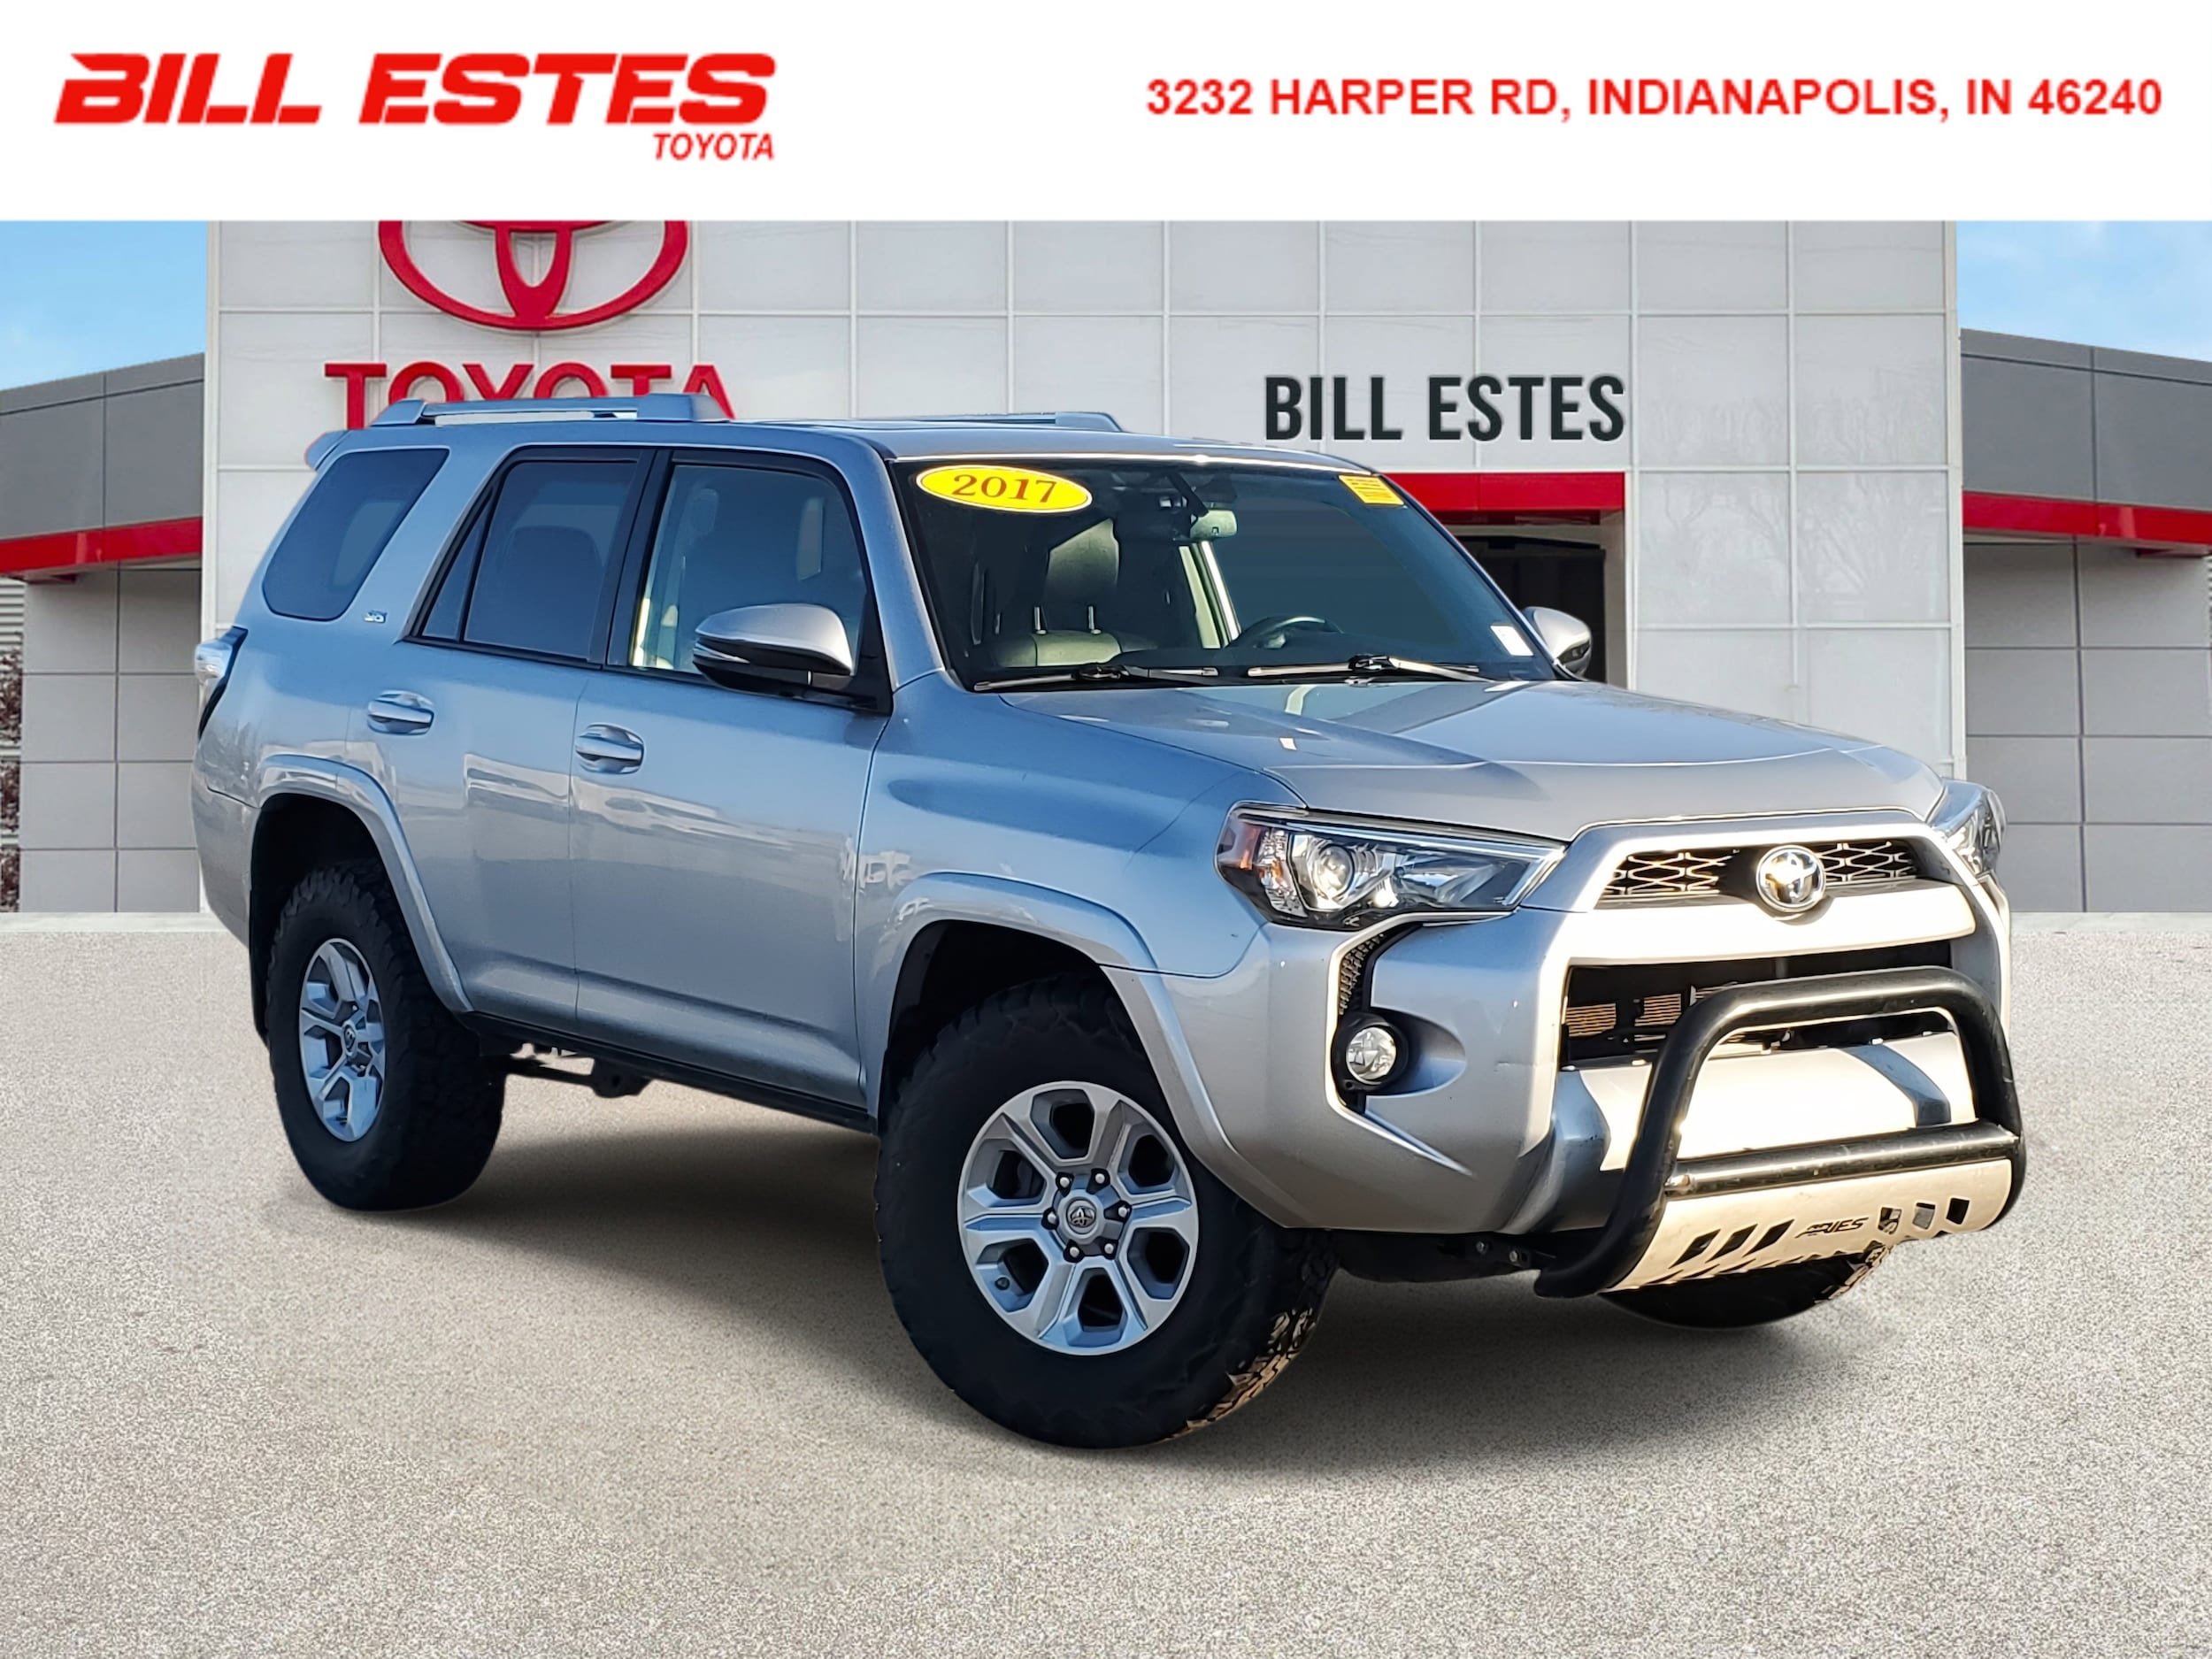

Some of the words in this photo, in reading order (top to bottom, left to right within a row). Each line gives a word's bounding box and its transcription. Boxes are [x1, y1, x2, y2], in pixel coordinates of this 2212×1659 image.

[1265, 376, 1402, 441] BILL
[1429, 375, 1624, 442] ESTES
[952, 474, 1057, 503] 2017
